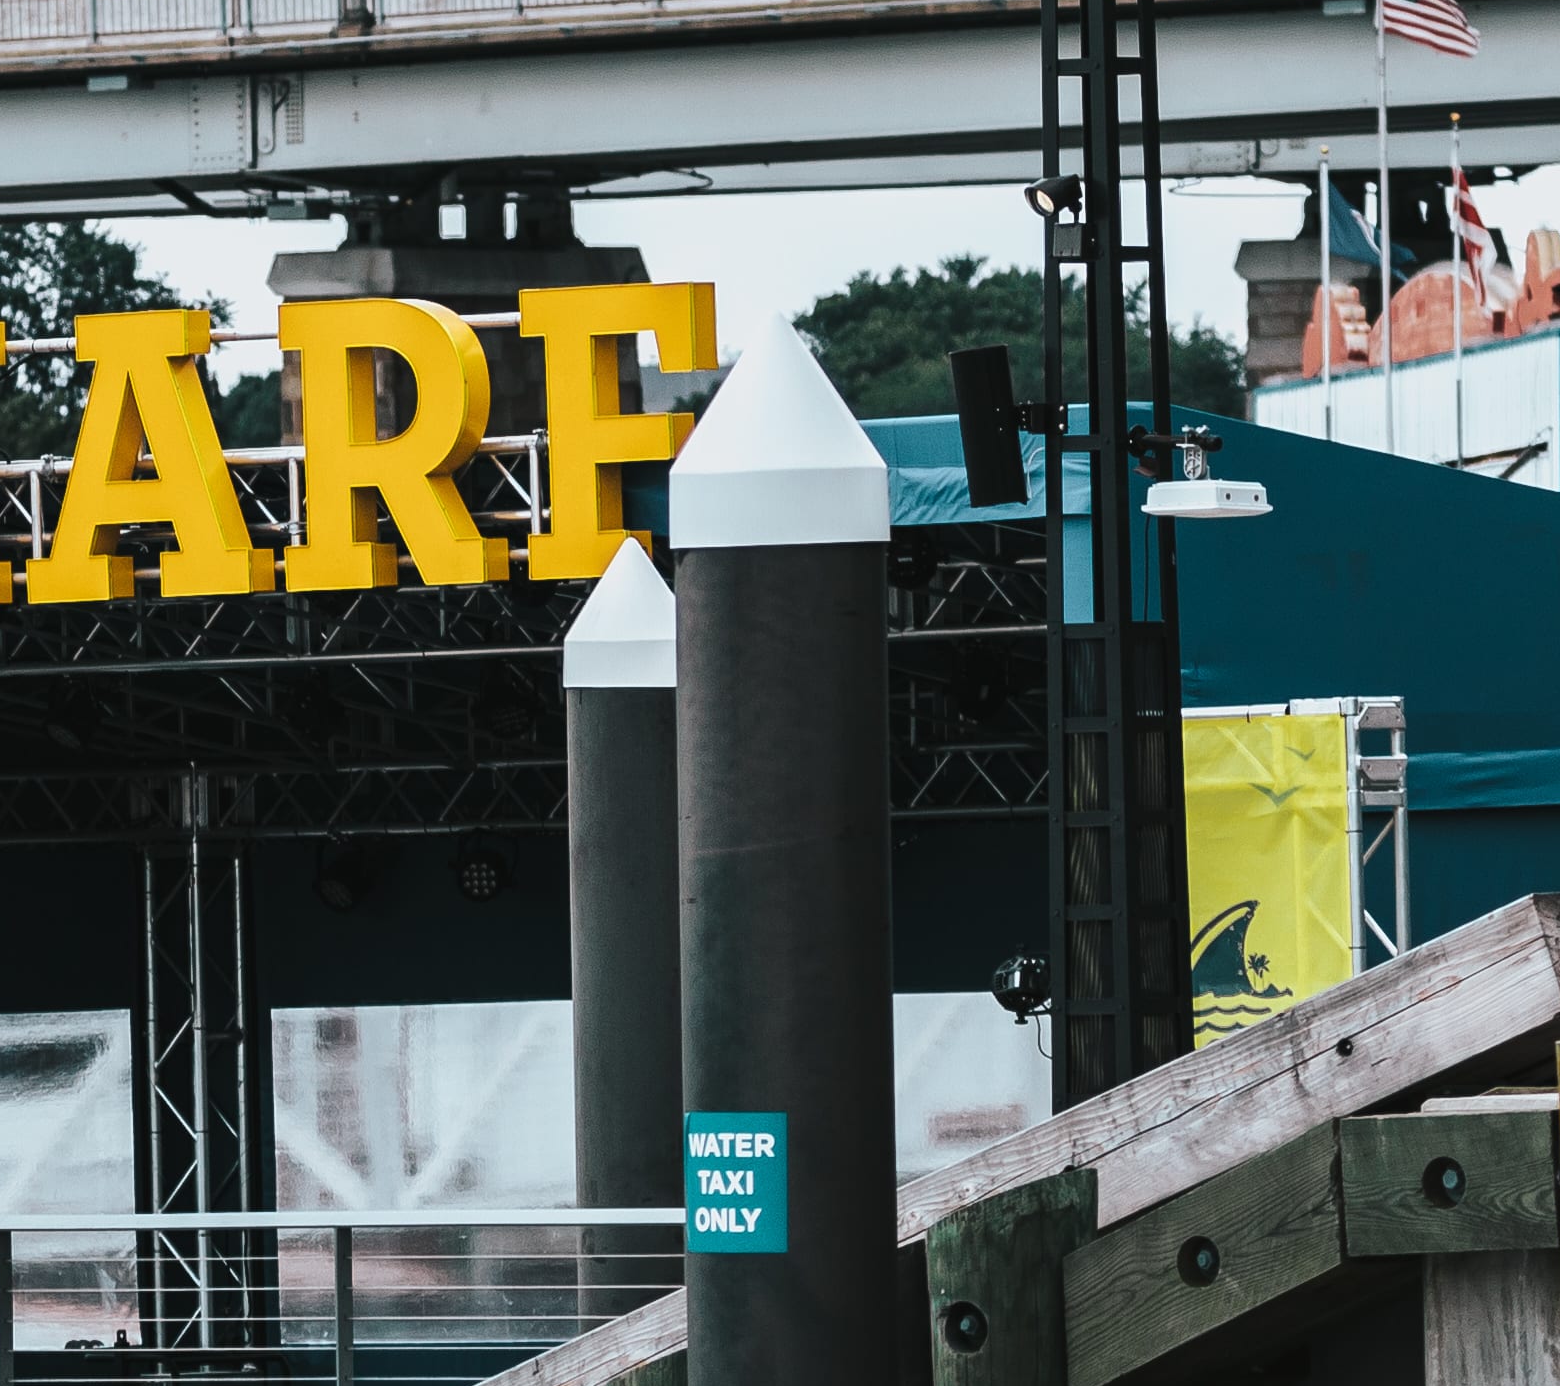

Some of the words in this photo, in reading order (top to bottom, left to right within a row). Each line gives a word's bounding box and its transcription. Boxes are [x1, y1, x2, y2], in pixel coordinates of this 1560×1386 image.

[688, 1132, 776, 1158] WATER
[697, 1170, 754, 1195] TAXI
[695, 1207, 762, 1233] ONLY
